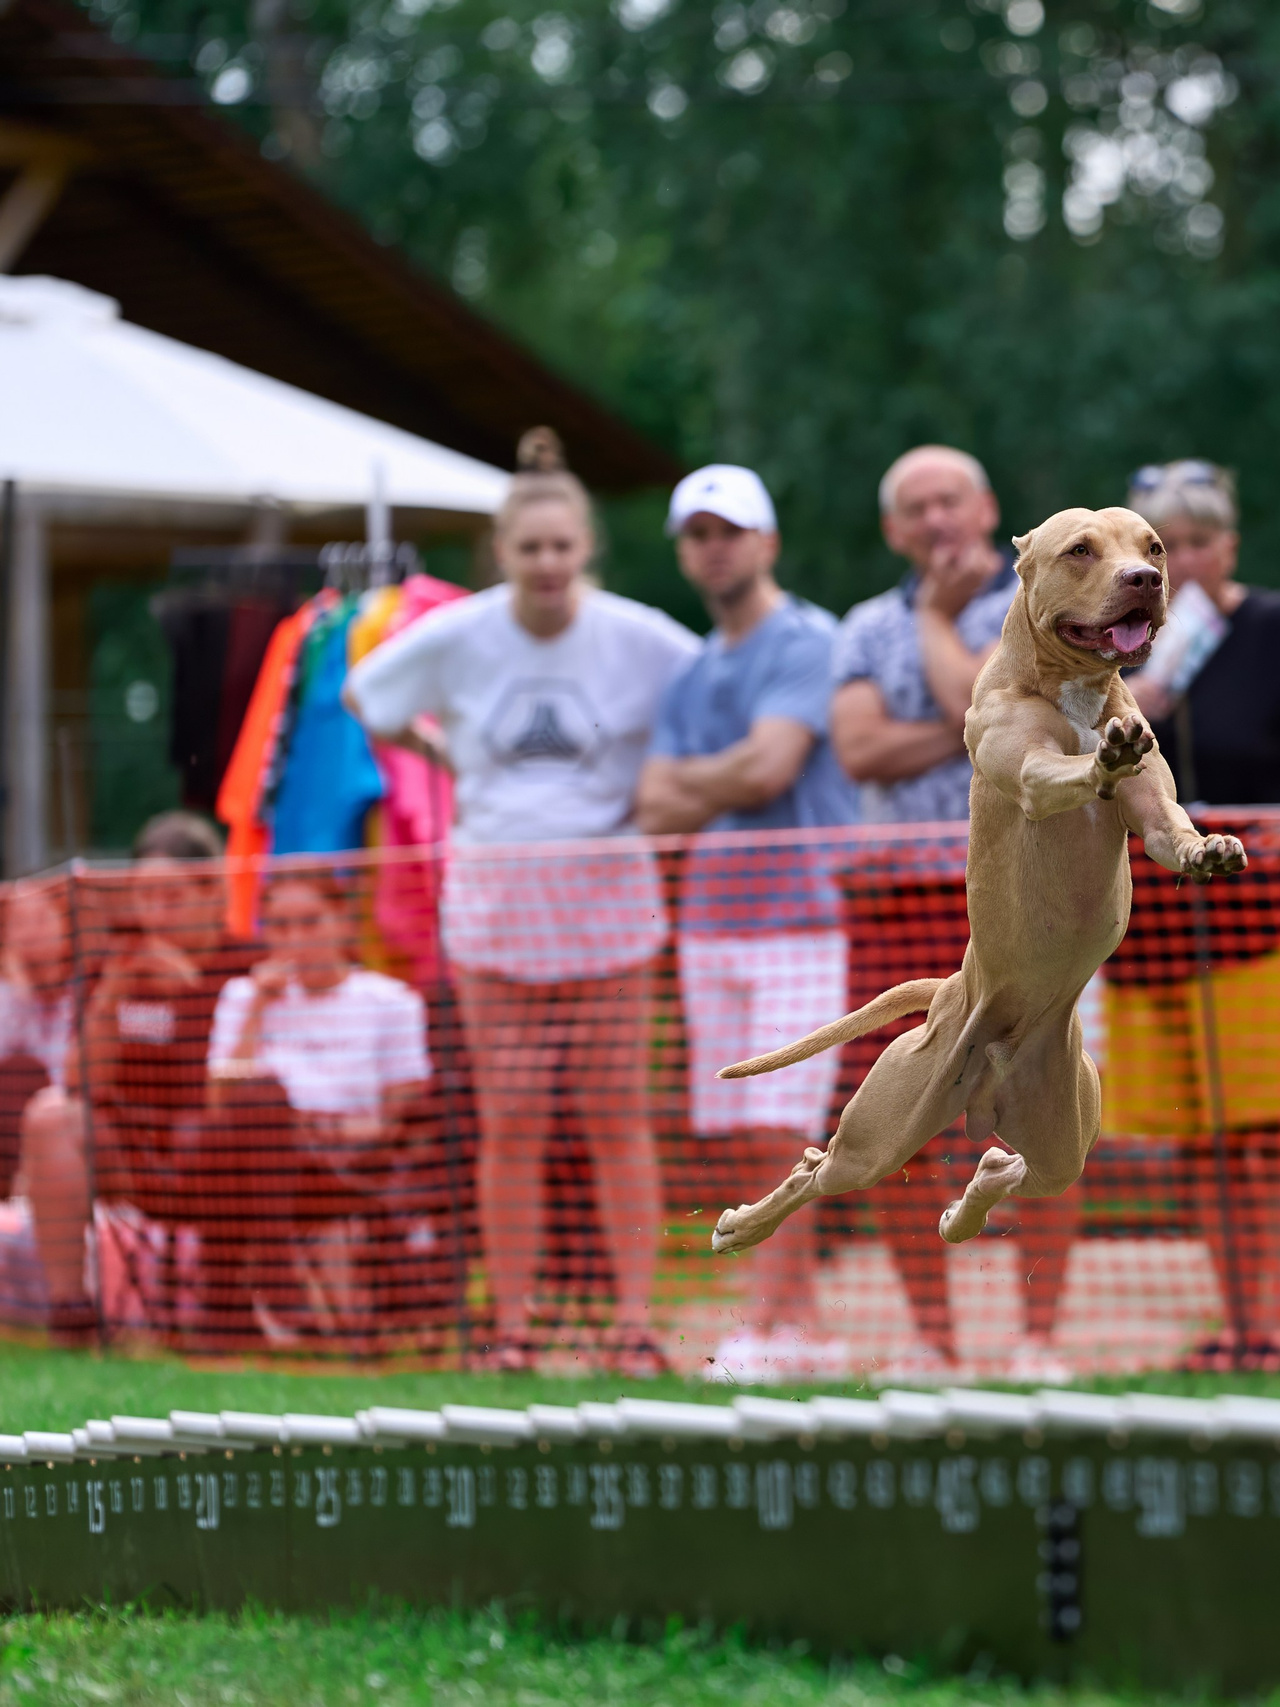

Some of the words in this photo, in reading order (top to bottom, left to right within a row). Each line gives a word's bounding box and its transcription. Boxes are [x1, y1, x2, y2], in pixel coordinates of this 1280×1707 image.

[3, 1487, 14, 1518] 11
[24, 1486, 37, 1518] 12
[45, 1484, 57, 1516] 13
[66, 1481, 79, 1513] 14
[86, 1481, 105, 1533] 15
[109, 1480, 123, 1513] 16
[130, 1477, 144, 1511] 17
[177, 1473, 192, 1509] 19
[195, 1474, 219, 1529] 20
[315, 1468, 340, 1527] 25
